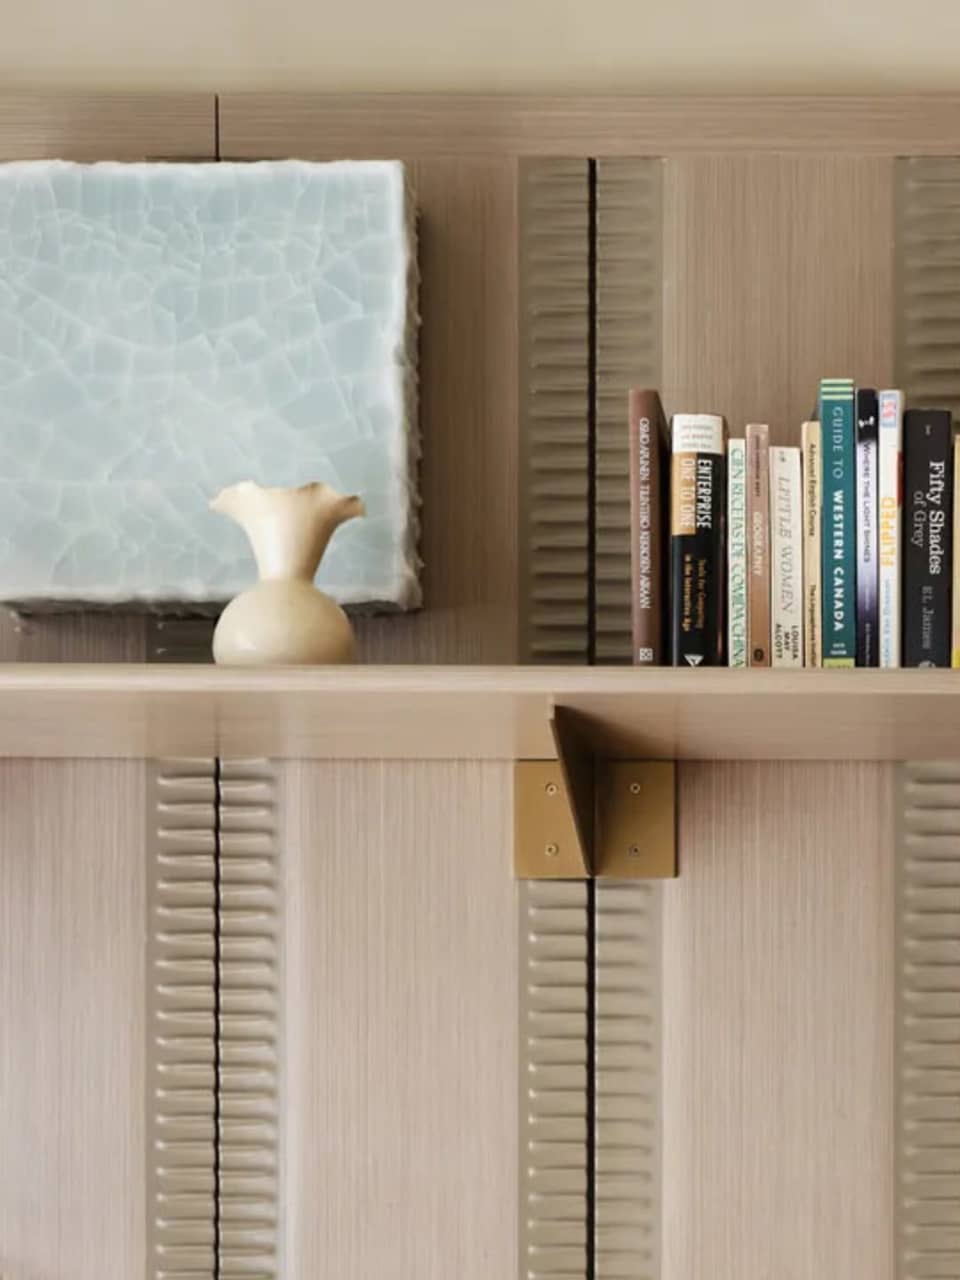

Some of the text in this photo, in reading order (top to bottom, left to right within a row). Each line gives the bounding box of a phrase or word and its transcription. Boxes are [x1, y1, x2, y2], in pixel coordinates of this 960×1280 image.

[832, 405, 844, 452] GUIDE
[832, 458, 844, 479] TO
[863, 481, 871, 498] THE
[681, 458, 696, 528] ONE TO ONE
[696, 459, 713, 529] ENTERPRISE
[807, 480, 817, 508] English
[863, 501, 871, 527] LIGHT
[808, 510, 817, 537] Course
[833, 489, 845, 560] WESTERN
[880, 496, 897, 567] FLIPPED
[911, 490, 926, 549] of Grey
[926, 460, 945, 575] Fifty Shades
[778, 476, 794, 614] LITTLE WOMEN
[833, 567, 845, 632] CANADA
[775, 623, 783, 659] ALCOTT
[791, 625, 799, 659] LOUISA
[920, 607, 934, 650] James
